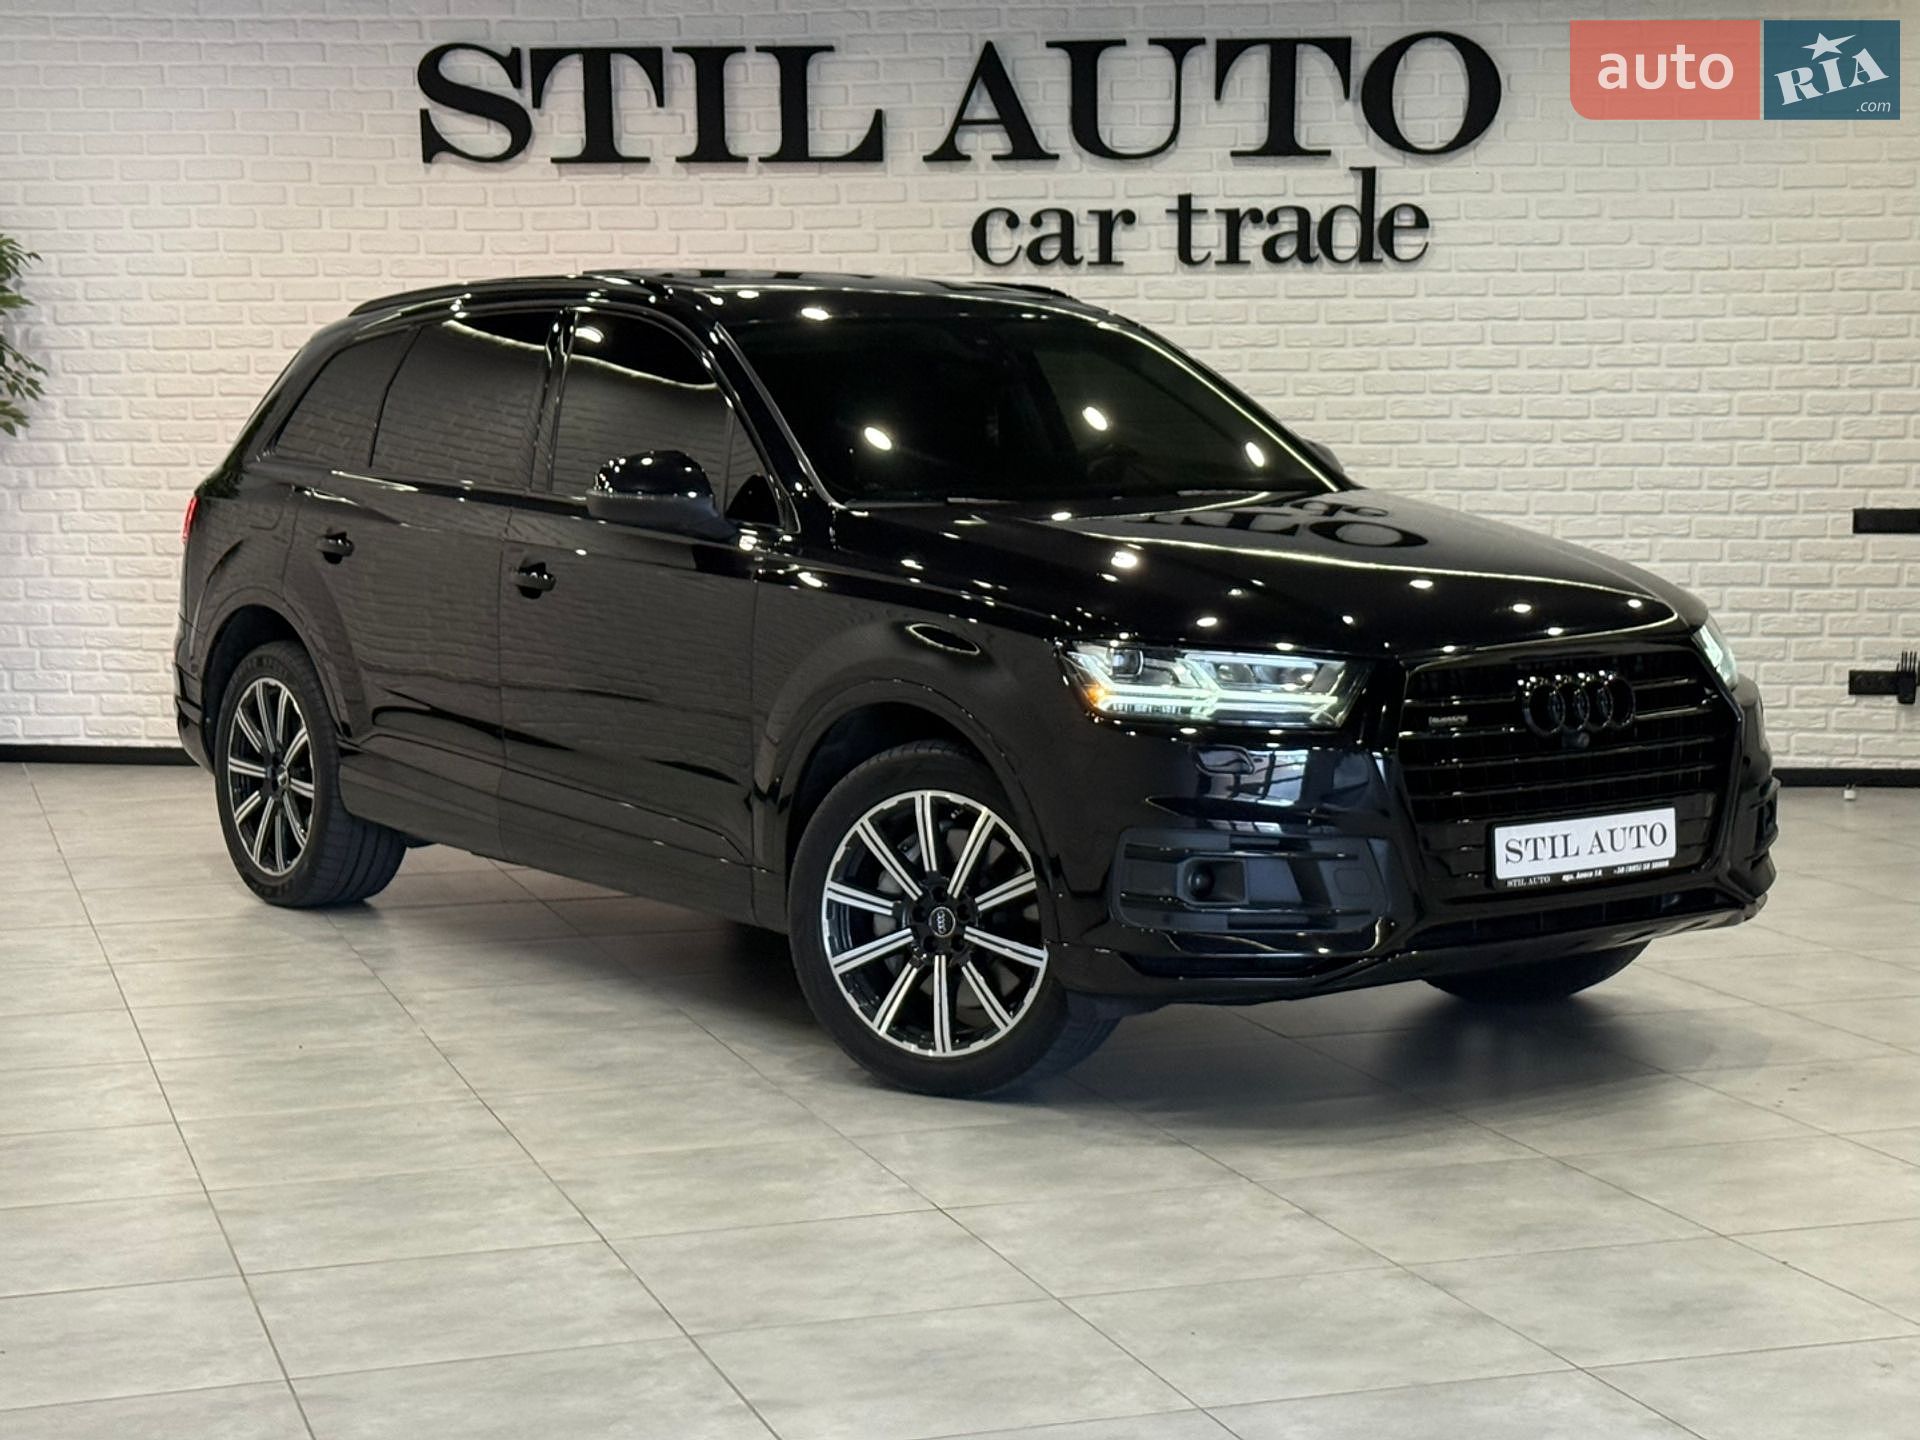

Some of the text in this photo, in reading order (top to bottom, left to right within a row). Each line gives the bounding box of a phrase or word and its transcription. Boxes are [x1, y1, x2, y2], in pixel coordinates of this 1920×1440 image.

[417, 31, 1502, 164] STIL AUTO
[970, 166, 1430, 267] car trade
[1505, 821, 1668, 865] STIL AUTO
[1528, 874, 1551, 886] AUTO
